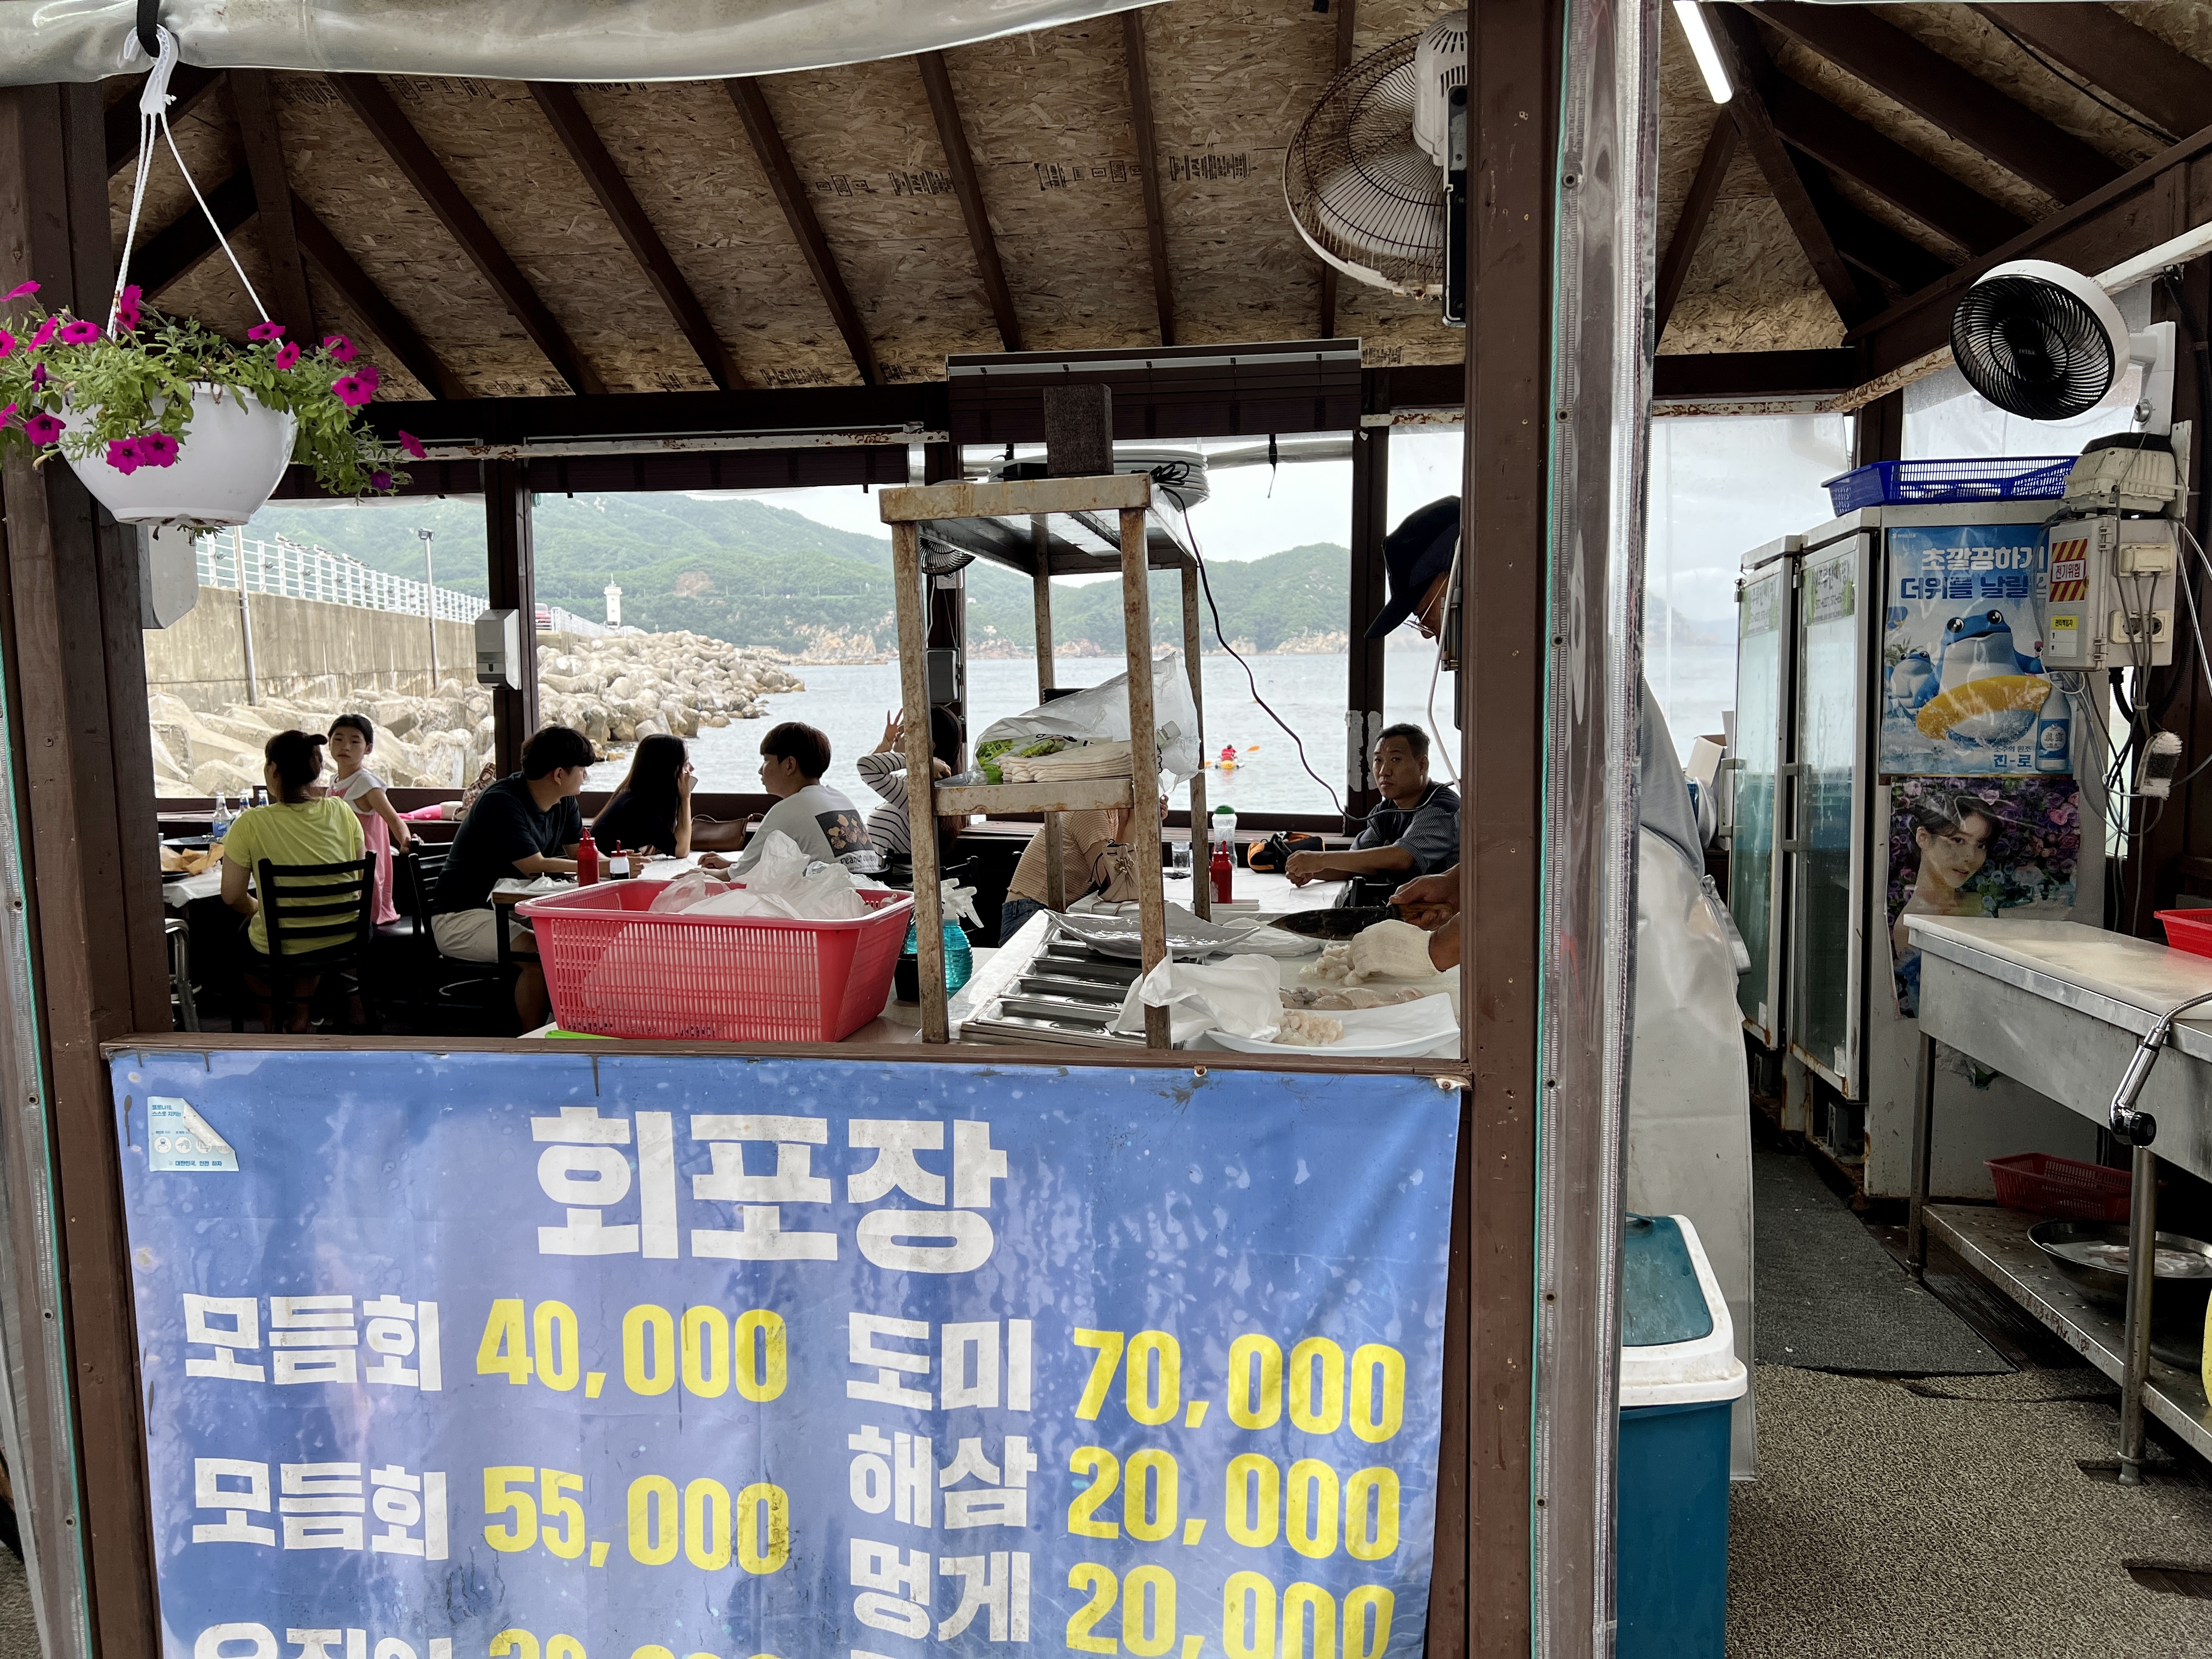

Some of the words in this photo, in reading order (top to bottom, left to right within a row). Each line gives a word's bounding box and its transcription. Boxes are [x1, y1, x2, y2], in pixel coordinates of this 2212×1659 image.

[910, 174, 923, 192] APA
[1191, 158, 1200, 177] APA
[1900, 576, 1973, 600] 더위를
[1980, 575, 2029, 599] 날릴
[2056, 562, 2081, 580] 전기위험
[531, 1105, 1008, 1274] 회포장
[184, 1293, 442, 1391] 모듬회
[476, 1299, 787, 1402] 40,000
[846, 1311, 1033, 1412] 도미
[1073, 1328, 1406, 1443] 70,000
[193, 1457, 449, 1561] 모듬회
[484, 1465, 789, 1575] 55,000
[848, 1424, 1037, 1530] 해삼
[1067, 1446, 1400, 1561] 20,000
[850, 1537, 1031, 1643] 멍게
